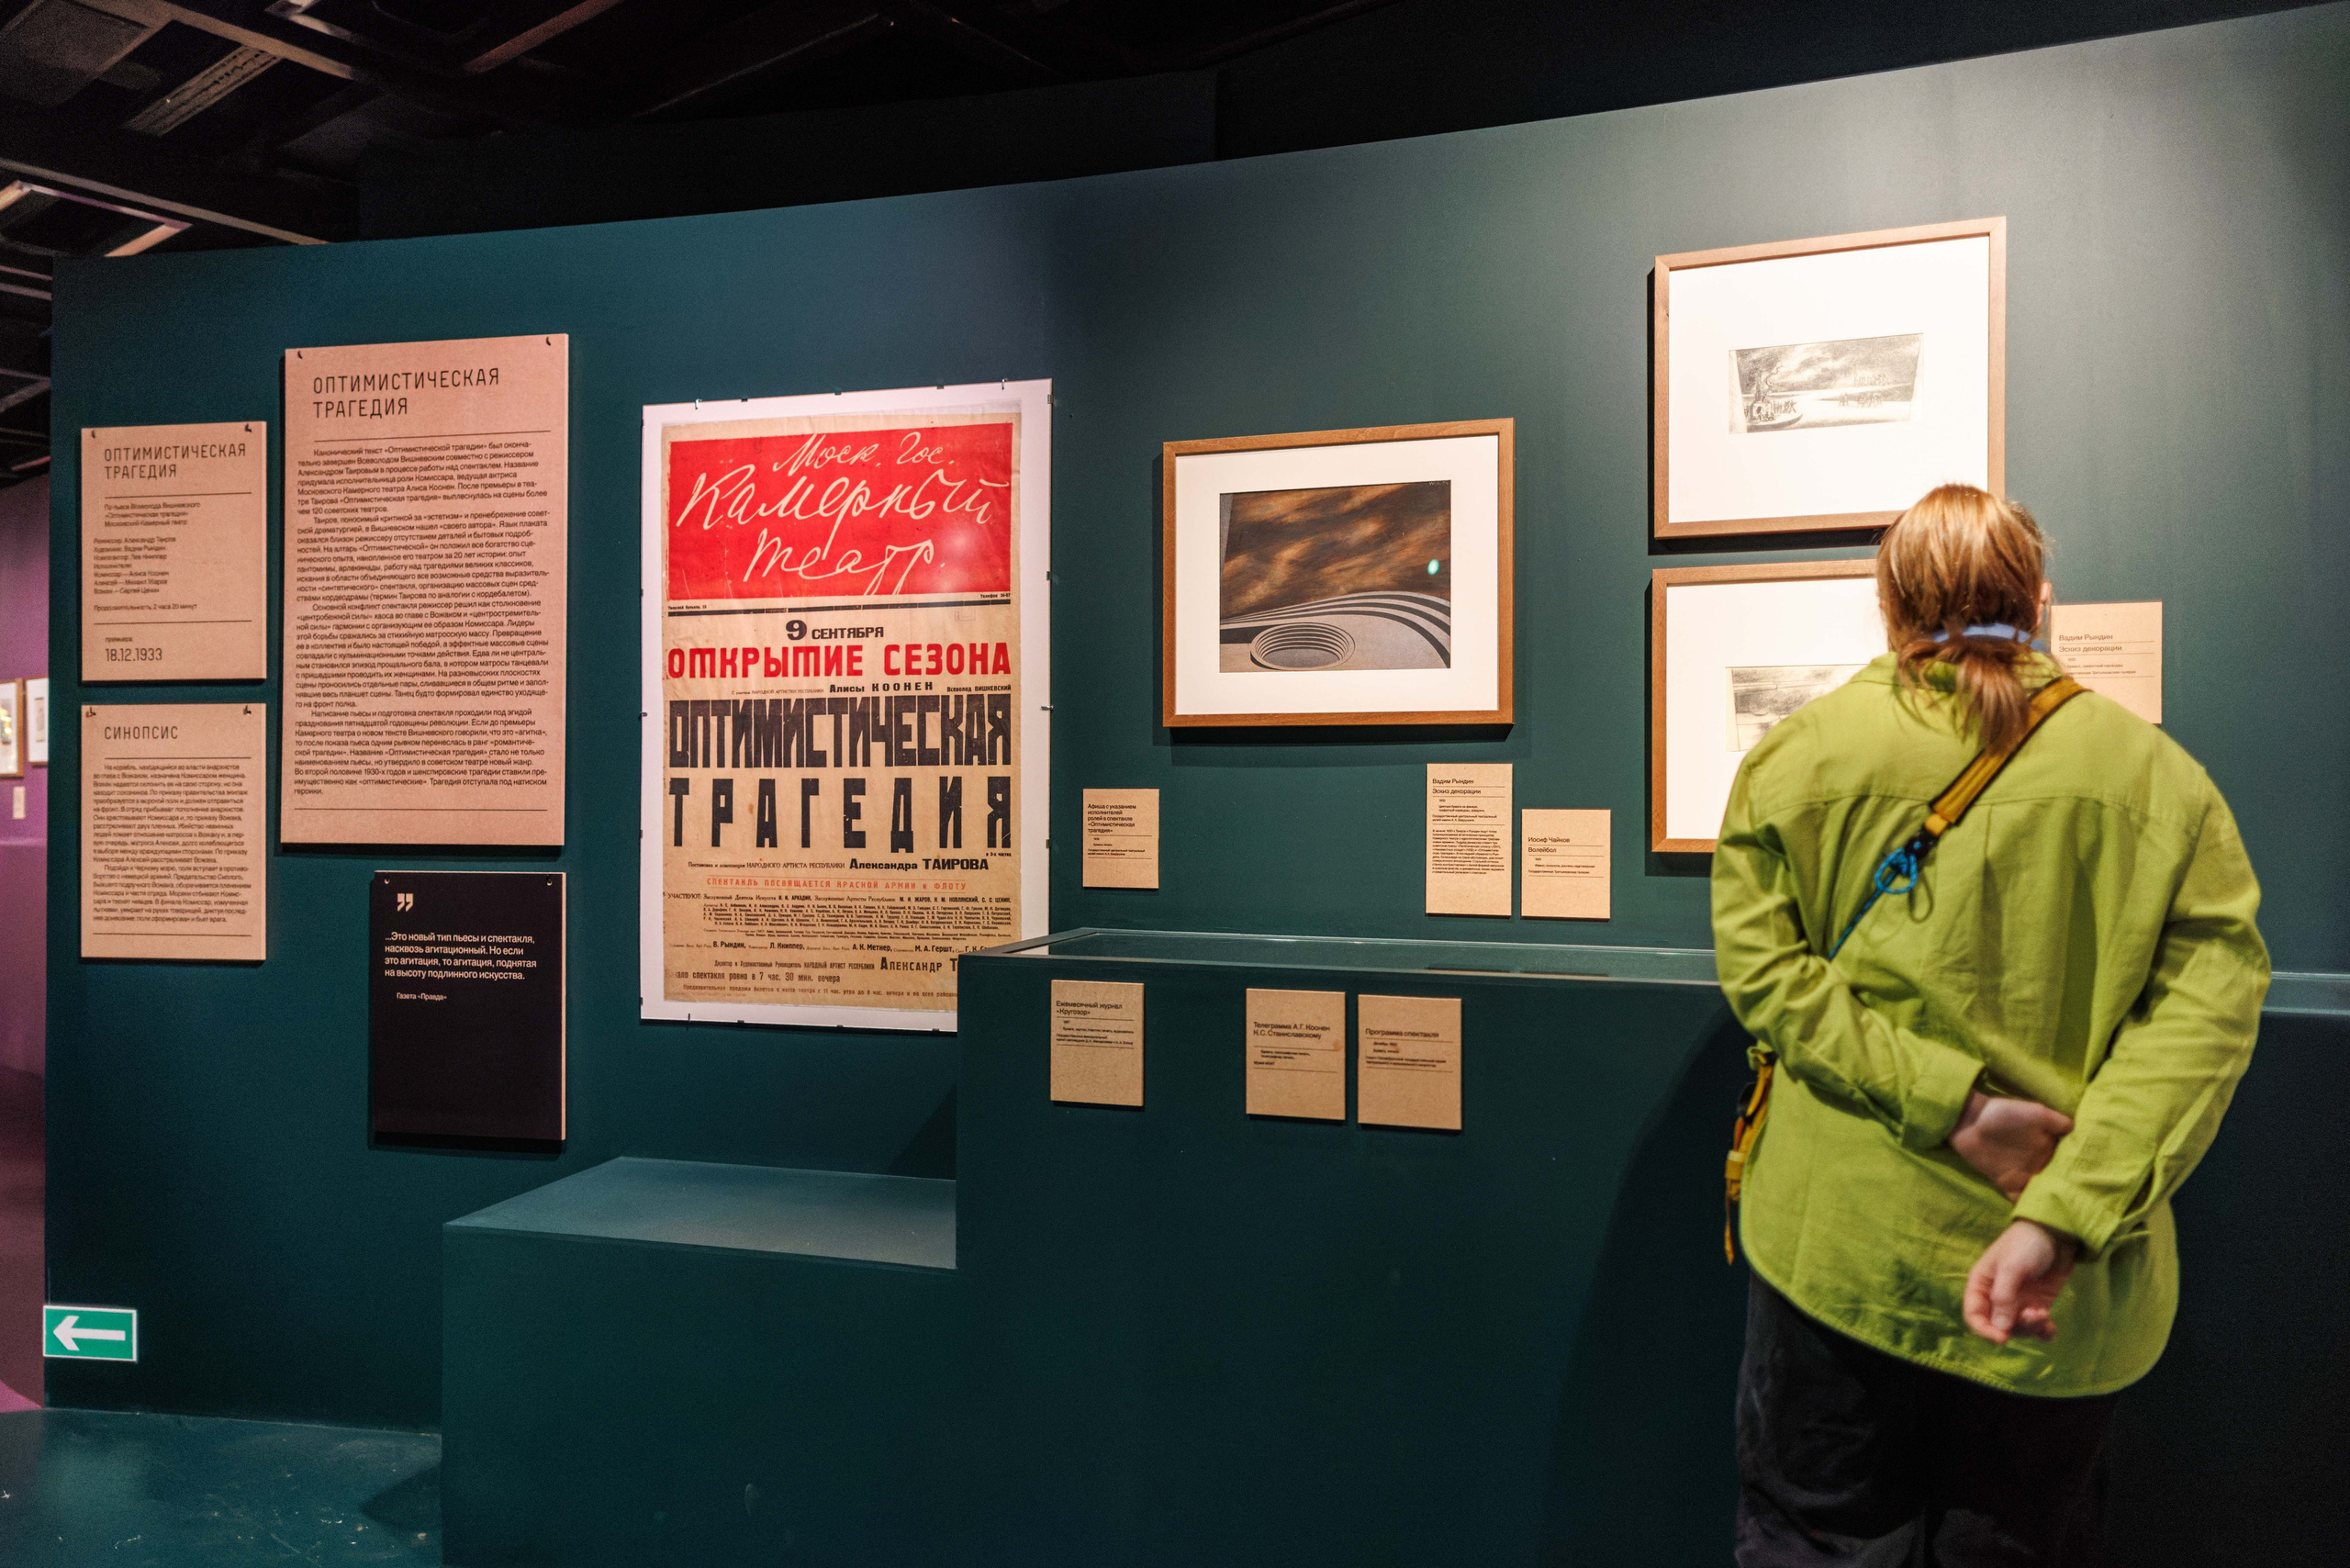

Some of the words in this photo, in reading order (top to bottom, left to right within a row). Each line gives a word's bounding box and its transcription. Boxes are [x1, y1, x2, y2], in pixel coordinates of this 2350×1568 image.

[313, 368, 499, 394] ОПТИМИСТИЧЕСКАЯ
[313, 398, 408, 419] ТРАГЕДИЯ
[104, 443, 246, 461] ОПТИМИСТИЧЕСКАЯ
[314, 448, 363, 456] Канонический
[385, 444, 450, 454] «Оптимистической
[772, 432, 882, 478] Моск.
[898, 431, 955, 465] Гос.
[105, 464, 177, 480] ТРАГЕДИЯ
[676, 464, 1010, 561] Камерный
[387, 631, 425, 639] стихийную
[492, 629, 542, 638] Превращение
[786, 620, 807, 641] 9
[811, 625, 884, 640] СЕНТЯБРЯ
[106, 648, 162, 661] 18.12.1933
[668, 645, 863, 678] ОТКРЫТИЕ
[883, 642, 1011, 676] СЕЗОНА
[829, 683, 865, 694] Алисы
[872, 681, 933, 692] КООНЕН
[104, 726, 178, 740] СИНОПСИС
[669, 693, 1012, 768] ОПТИМИСТИЧЕСКАЯ
[669, 776, 1012, 854] ТРАГЕДИЯ
[850, 858, 917, 871] Александра
[923, 859, 989, 870] ТАИРОВА
[764, 880, 831, 888] ПОСВЯЩАЕТСЯ
[837, 880, 878, 889] КРАСНОЙ
[408, 932, 435, 941] новый
[488, 935, 535, 943] спектакля,
[425, 945, 488, 955] агитационный.
[489, 946, 502, 954] Но
[400, 958, 441, 967] агитация,
[453, 959, 494, 968] агитация,
[496, 960, 537, 969] поднятая
[880, 957, 942, 973] АЛЕКСАНДР
[396, 970, 426, 979] высоту
[428, 971, 478, 980] подлинного
[479, 972, 525, 981] искусства.
[665, 969, 689, 980] ало
[729, 973, 748, 982] ровно
[760, 972, 764, 980] 7
[785, 972, 794, 981] 30
[818, 975, 840, 984] вечера
[1365, 1028, 1403, 1037] Программа
